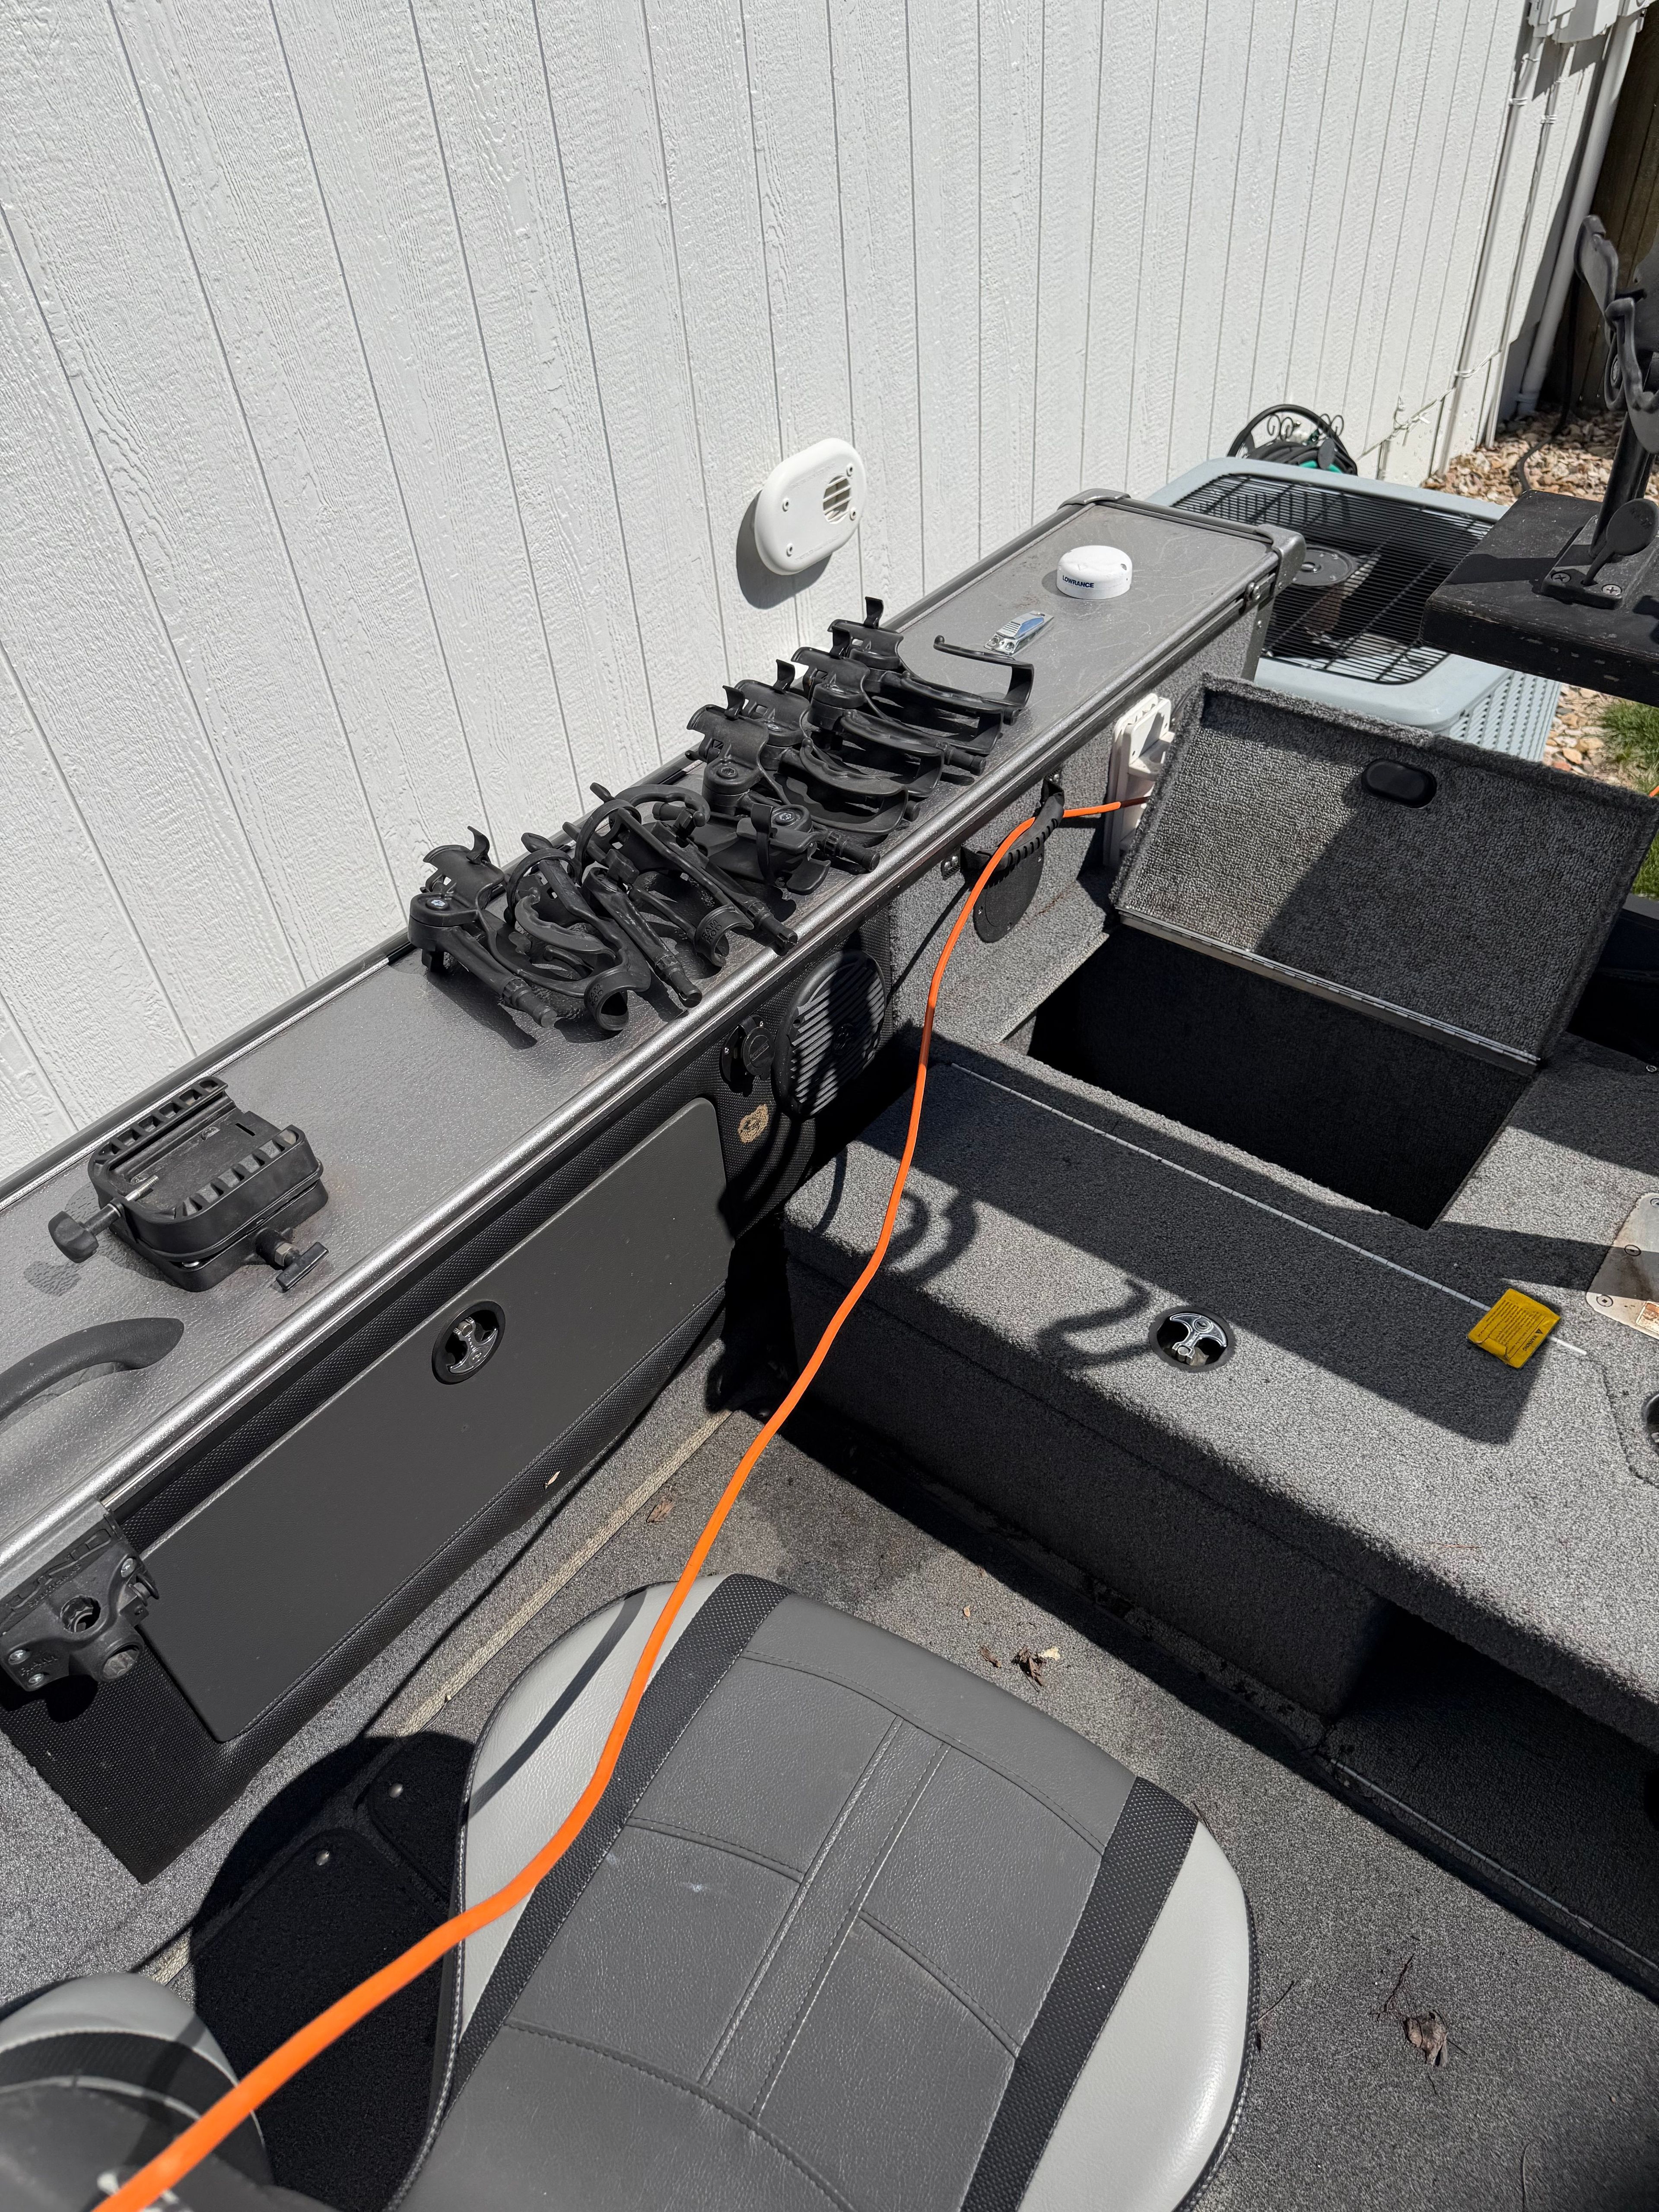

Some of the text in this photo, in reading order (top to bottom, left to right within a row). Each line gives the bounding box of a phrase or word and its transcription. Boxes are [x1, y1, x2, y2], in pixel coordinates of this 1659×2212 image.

[1062, 575, 1094, 588] LOWRANCE
[702, 920, 718, 939] RAM
[706, 925, 722, 943] ROD
[1522, 1335, 1538, 1351] WARNING
